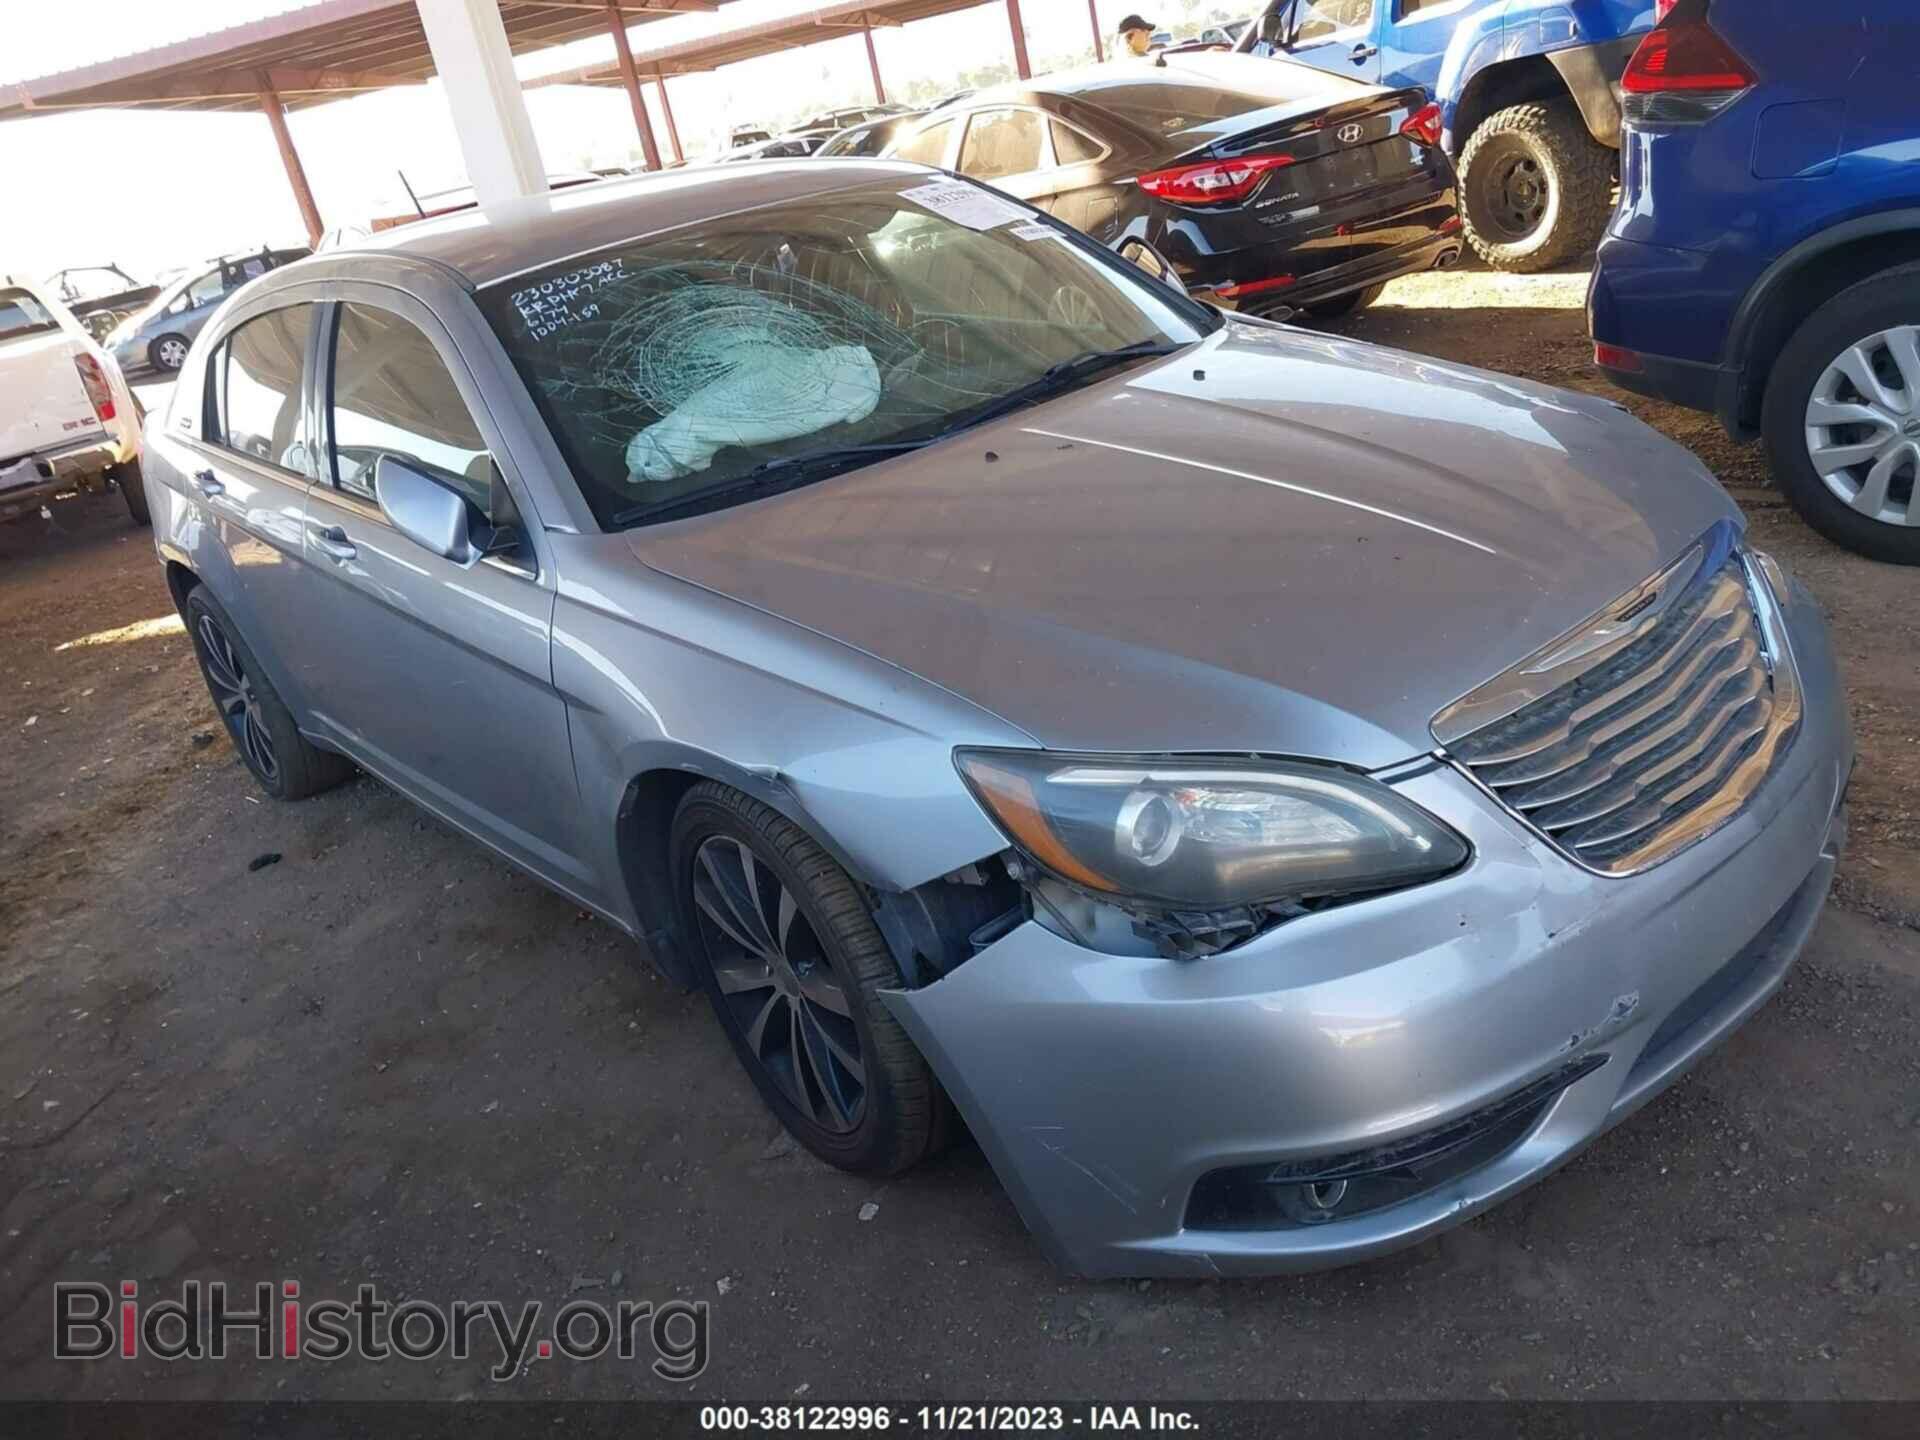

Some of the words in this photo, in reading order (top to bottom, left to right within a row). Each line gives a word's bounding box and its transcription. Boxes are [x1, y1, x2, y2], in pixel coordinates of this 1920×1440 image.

[1255, 192, 1300, 209] SONATA
[511, 258, 623, 306] 230303087
[527, 305, 569, 327] 6174
